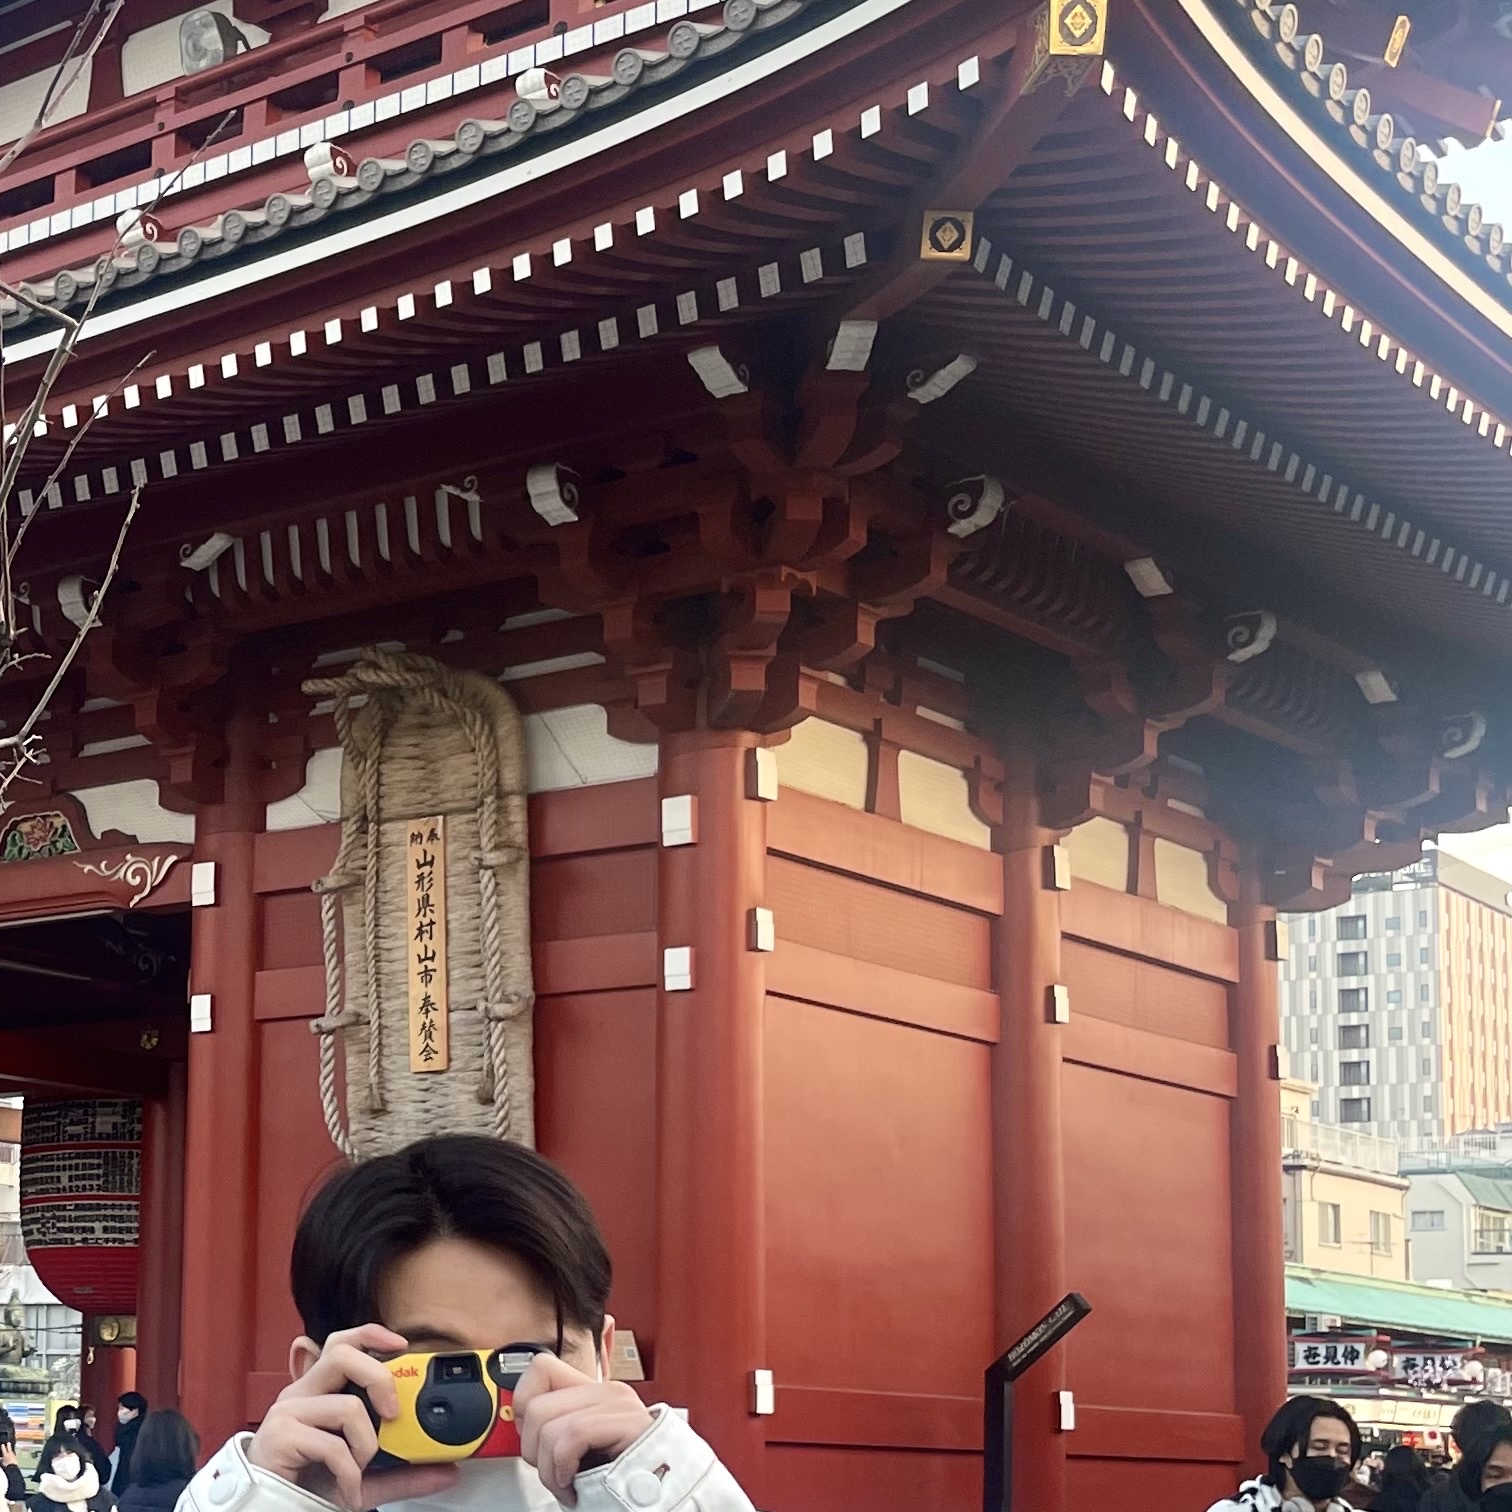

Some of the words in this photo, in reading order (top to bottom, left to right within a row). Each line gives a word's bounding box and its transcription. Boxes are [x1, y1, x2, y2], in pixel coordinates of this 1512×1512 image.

[414, 849, 440, 1063] 山形県村山市奉賛会
